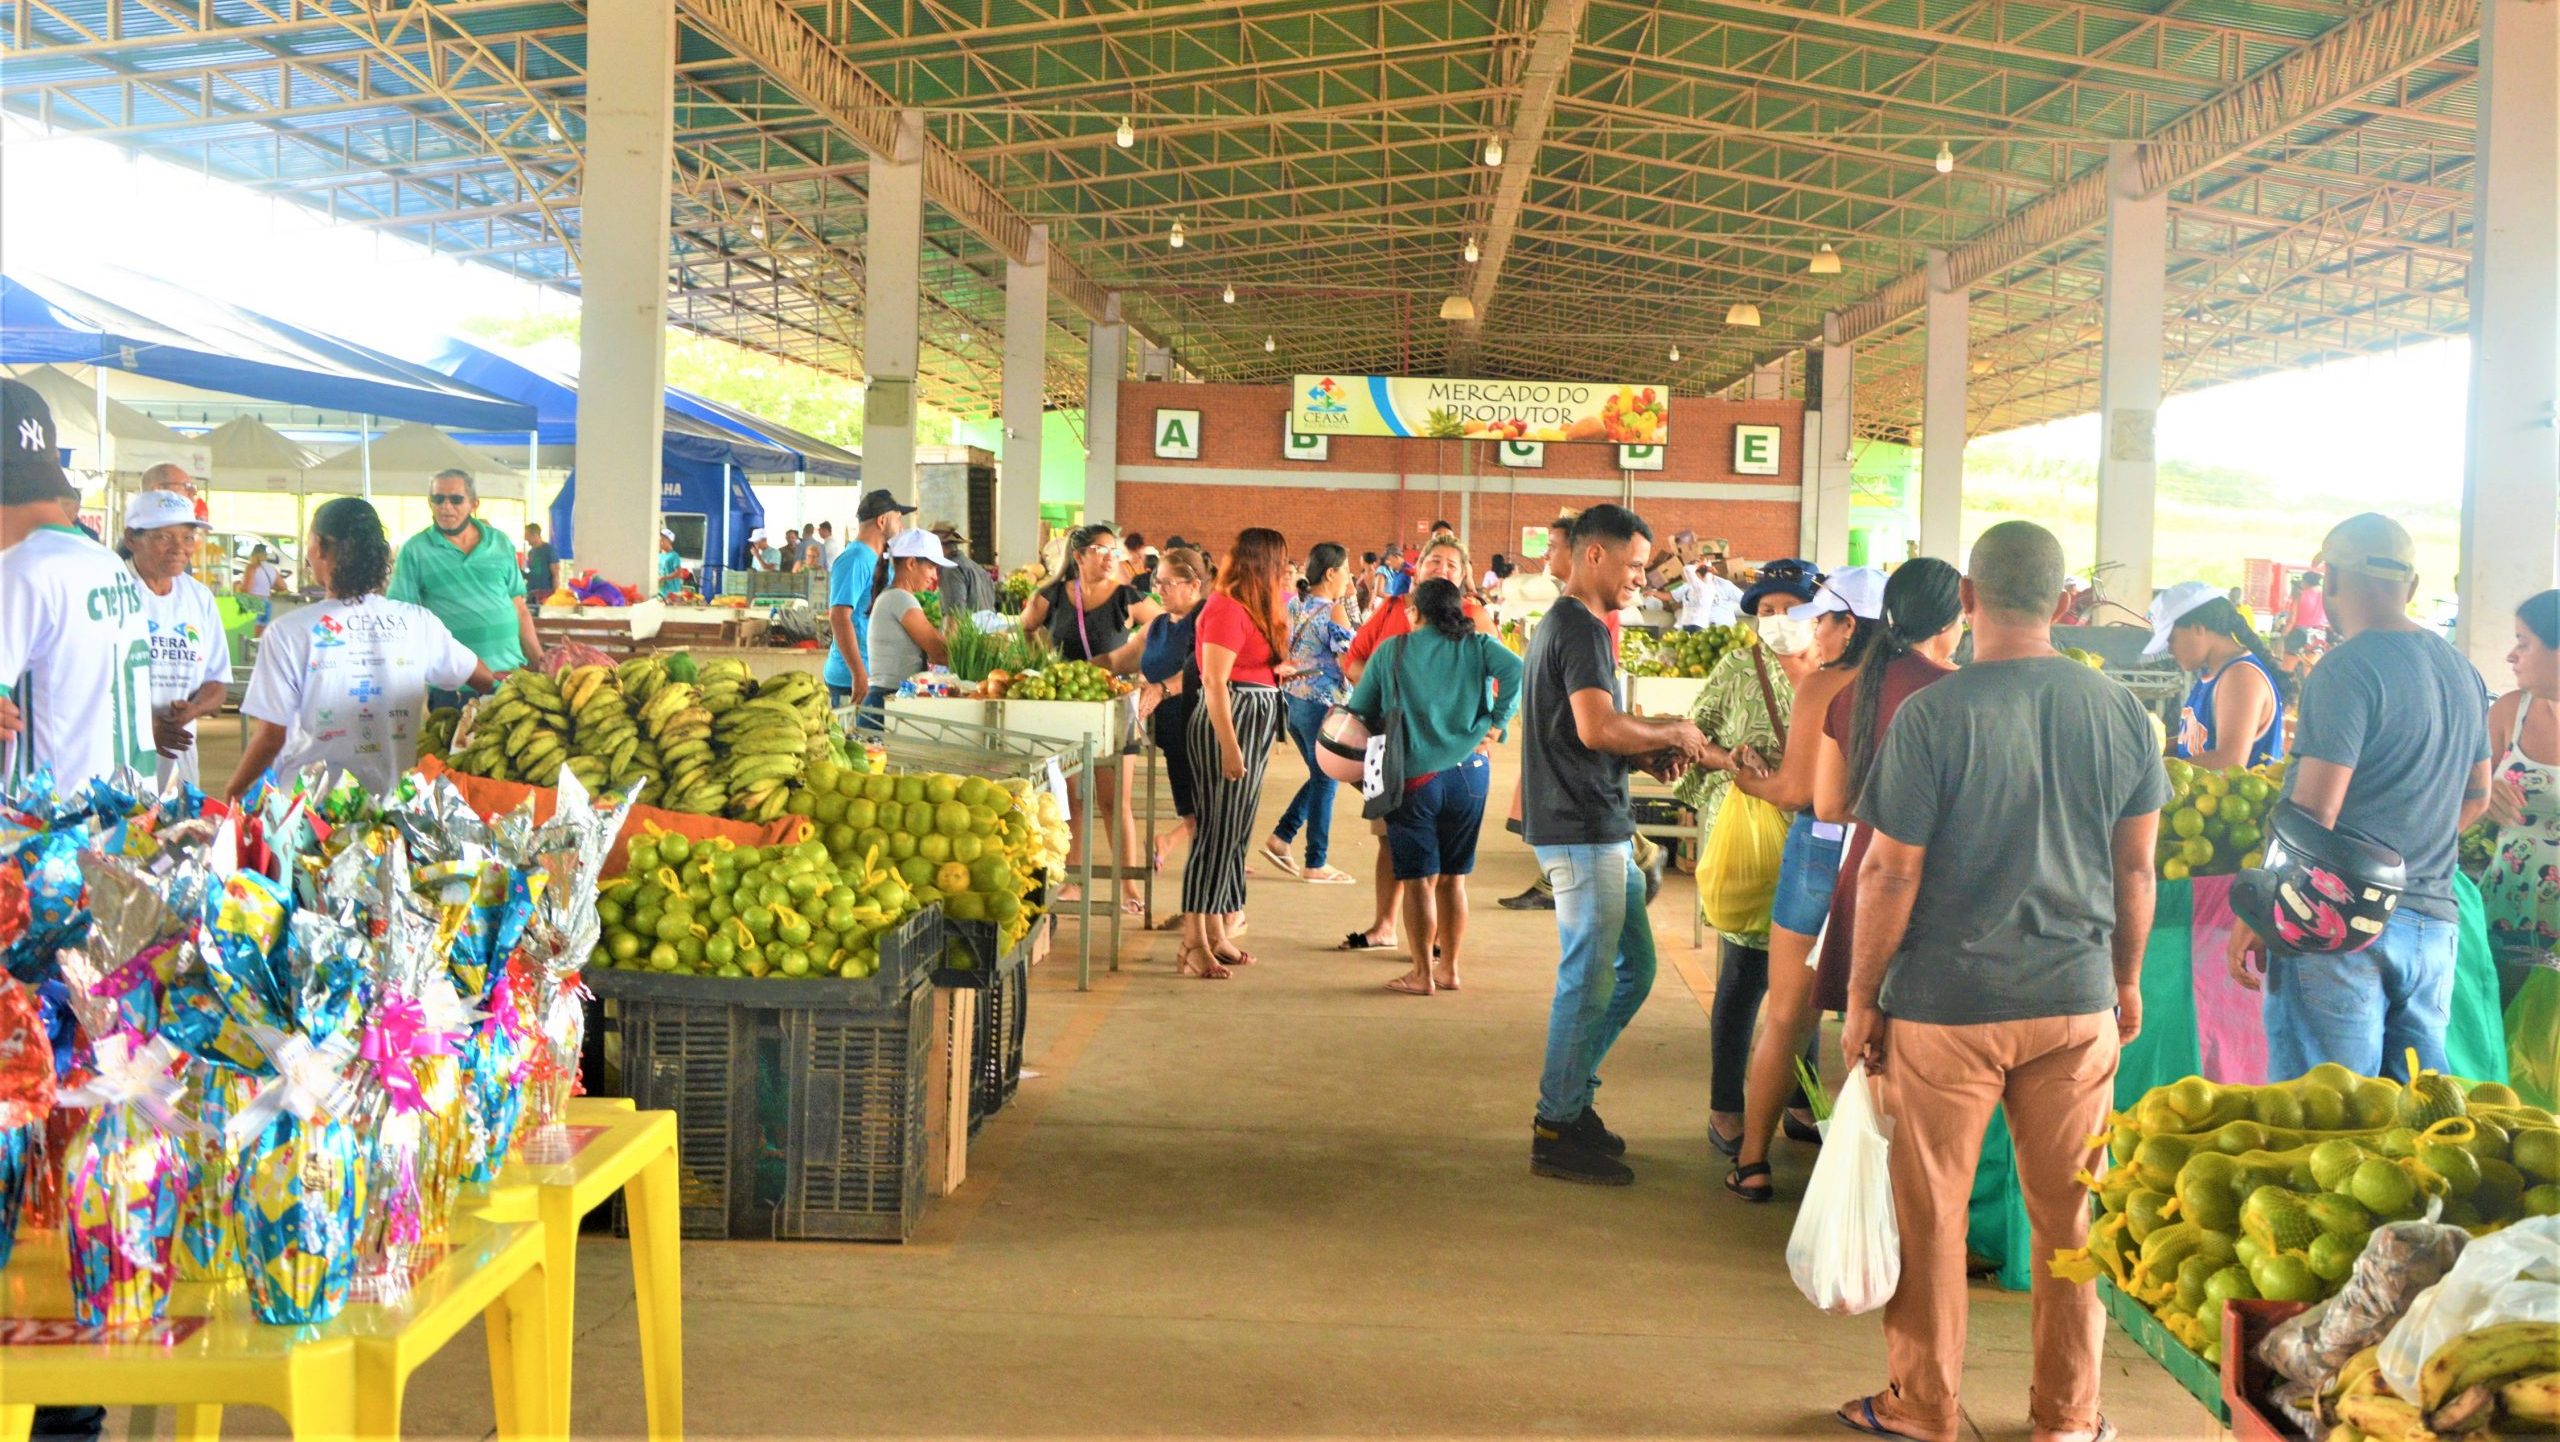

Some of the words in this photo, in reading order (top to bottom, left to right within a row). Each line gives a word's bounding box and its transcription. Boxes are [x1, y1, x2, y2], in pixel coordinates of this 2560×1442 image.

[1428, 383, 1550, 402] MERCADO
[1557, 387, 1589, 404] DO
[1303, 412, 1349, 424] CEASA
[1446, 404, 1573, 424] PRODUTOR
[1160, 419, 1189, 447] A
[1743, 434, 1768, 463] E
[347, 615, 408, 631] CEASA
[151, 636, 187, 648] FEIRA
[162, 649, 197, 661] PEIXE
